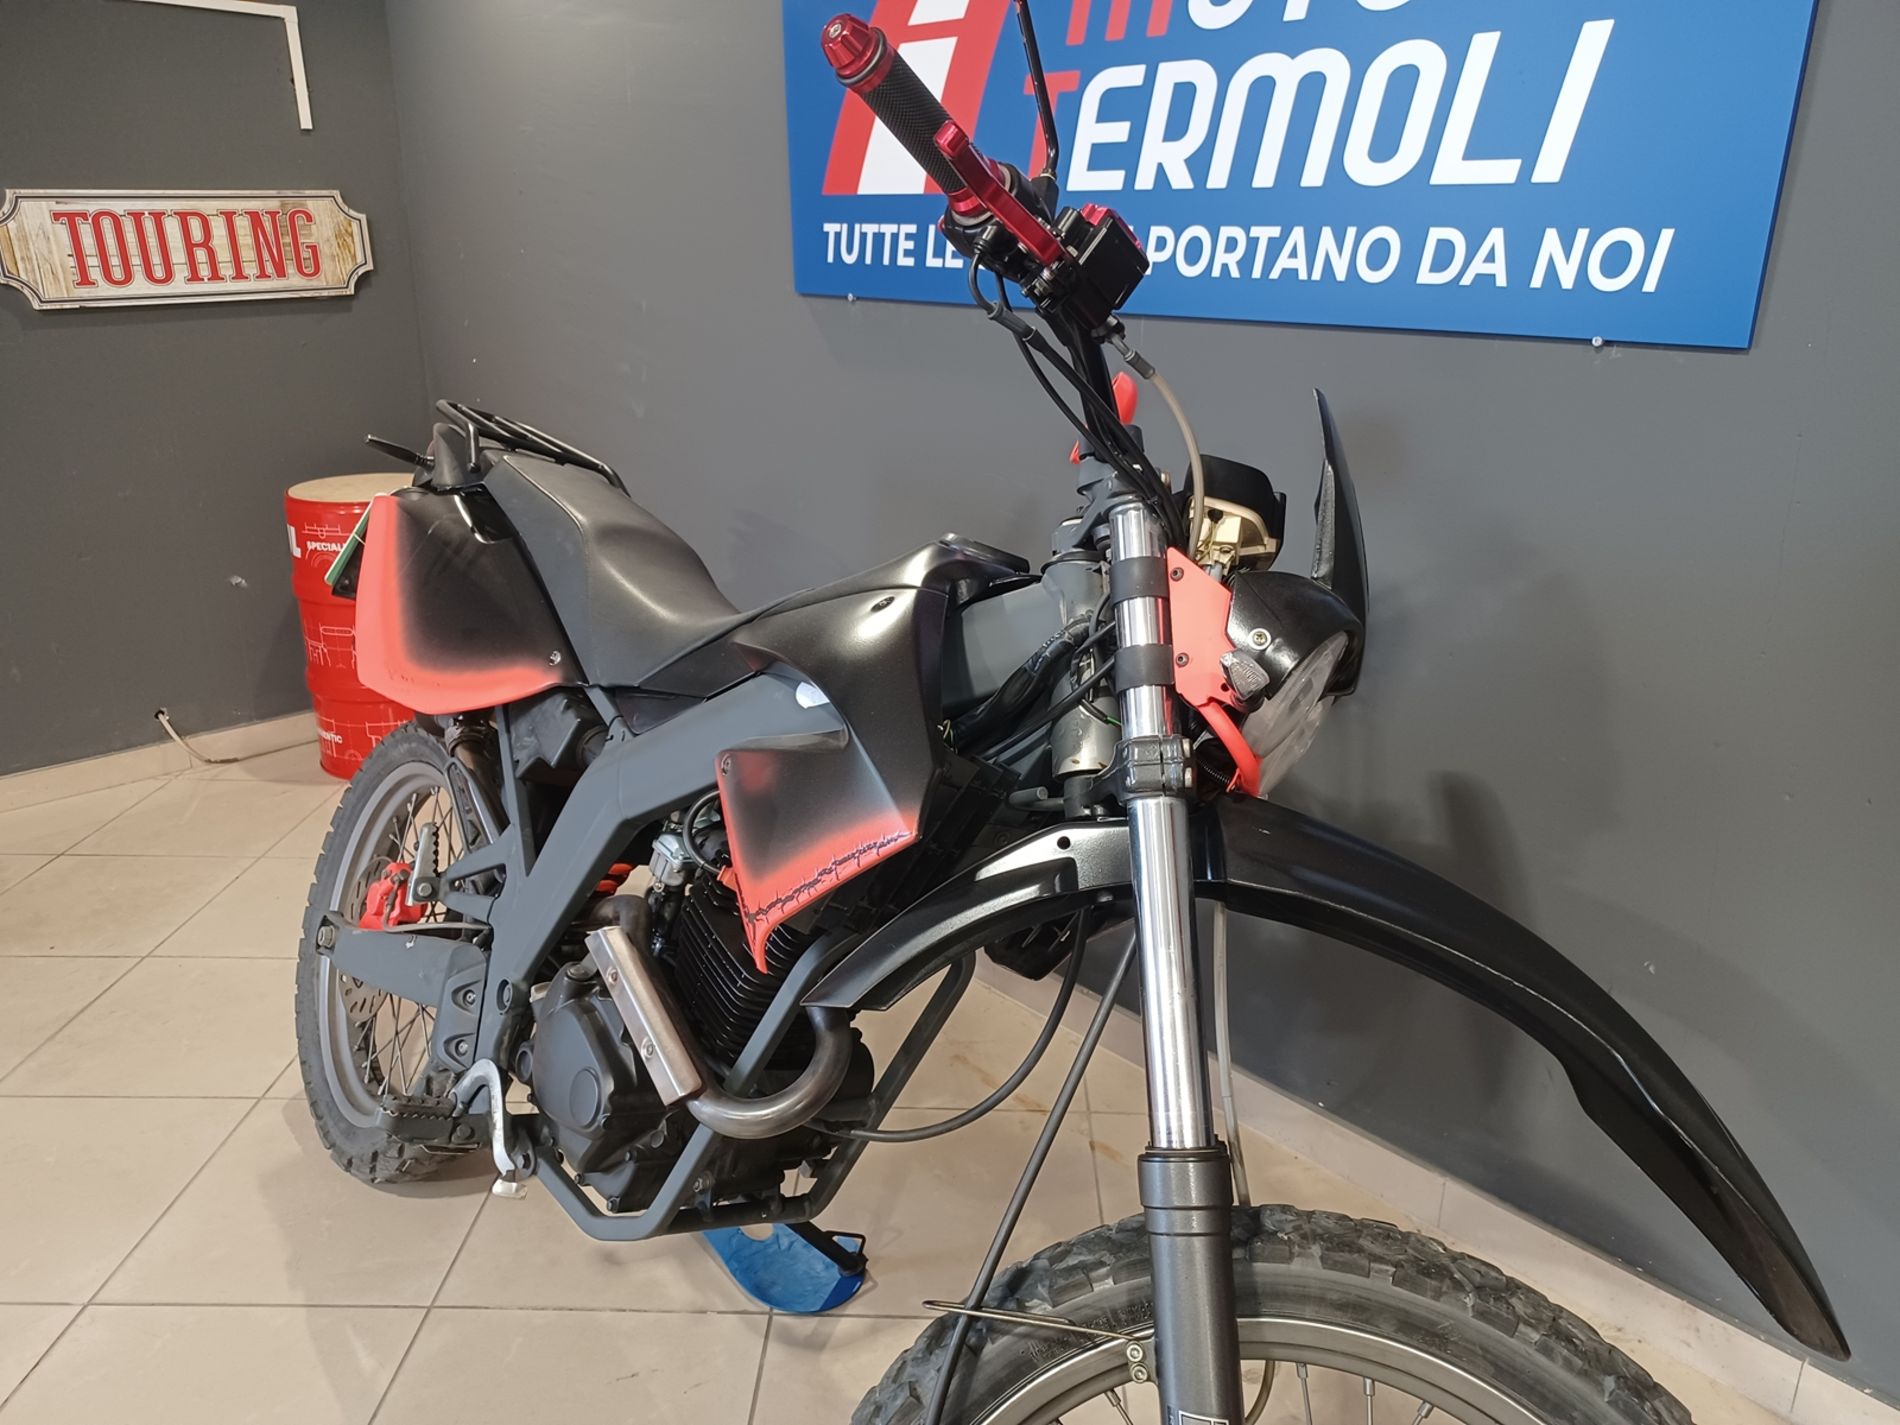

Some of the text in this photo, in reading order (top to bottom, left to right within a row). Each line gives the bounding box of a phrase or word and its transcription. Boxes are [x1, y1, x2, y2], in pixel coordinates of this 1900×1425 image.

[1024, 19, 1615, 191] TERMOLI
[51, 208, 322, 287] TOURING
[823, 222, 917, 268] TUTTE
[1144, 225, 1401, 284] PORTANO
[1416, 227, 1508, 288] DA
[1529, 227, 1675, 293] NOI
